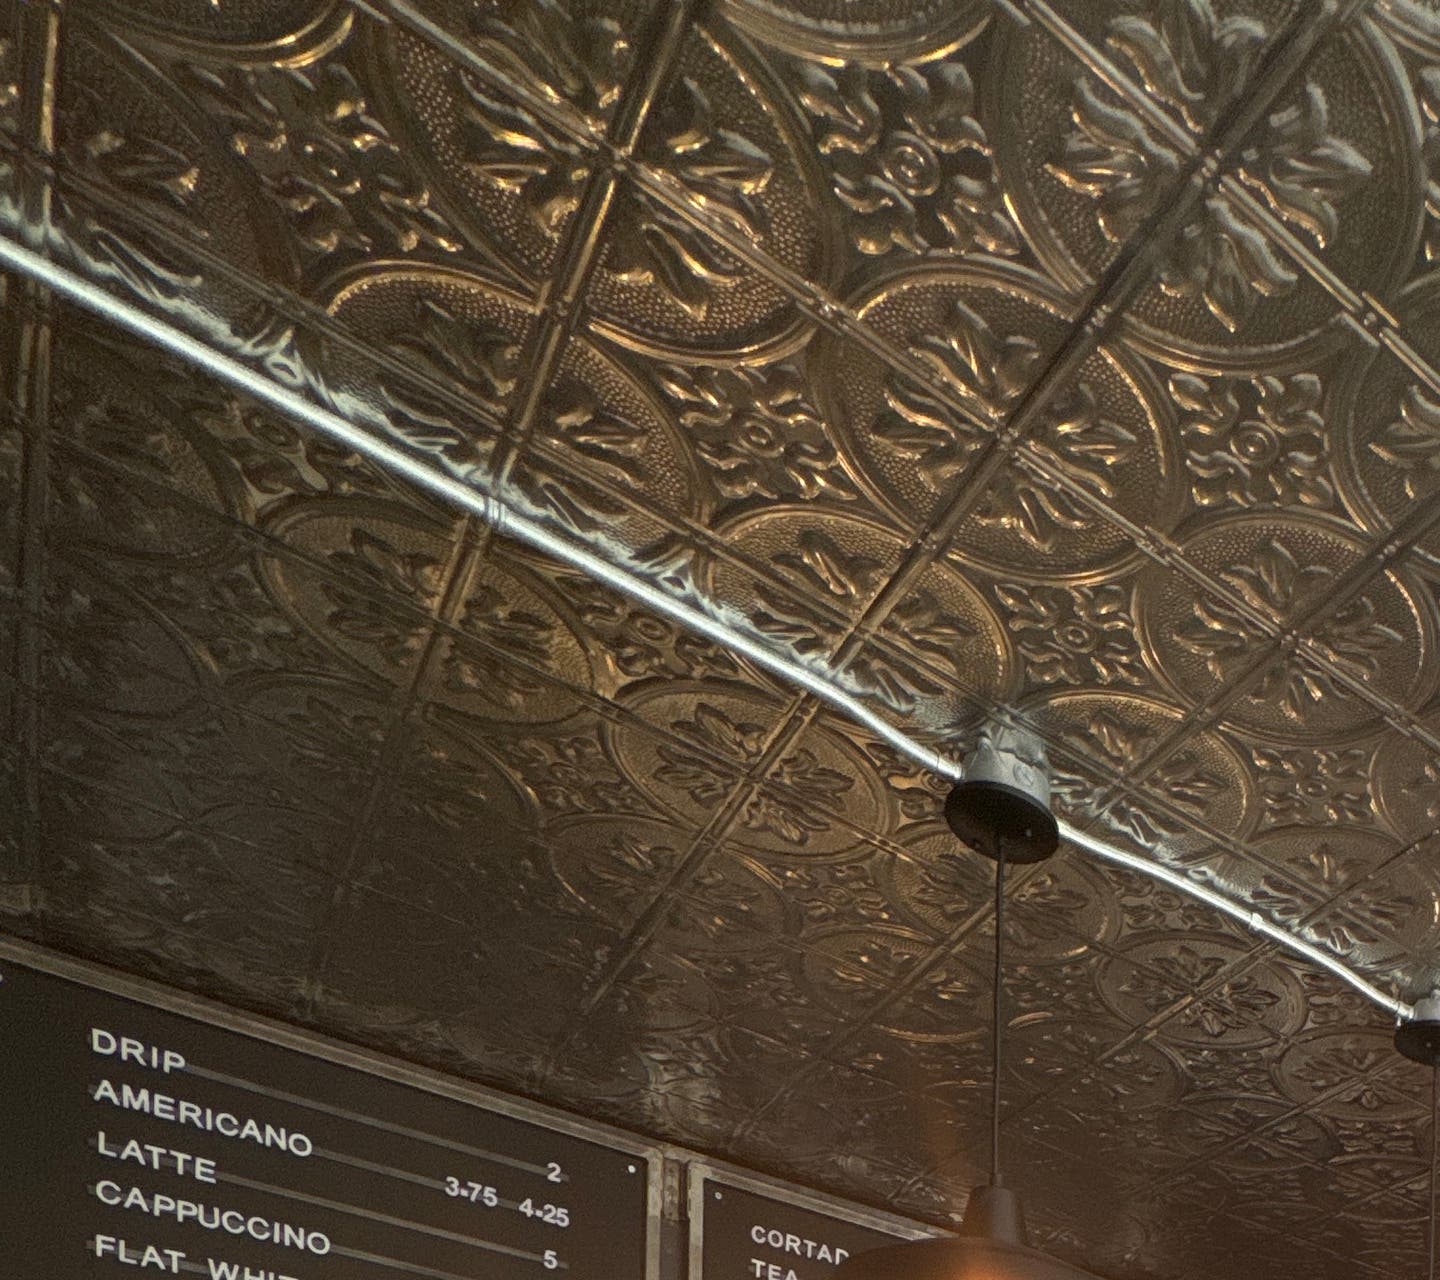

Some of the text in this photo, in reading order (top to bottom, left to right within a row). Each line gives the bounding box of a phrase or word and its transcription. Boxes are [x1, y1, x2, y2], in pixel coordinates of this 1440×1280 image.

[91, 1028, 561, 1183] DRIP 2
[94, 1079, 312, 1157] AMERICANO
[95, 1180, 331, 1255] CAPPUCCINO
[98, 1131, 558, 1269] LATTE 5
[95, 1234, 186, 1273] FLAT
[751, 1225, 849, 1265] CORTAD
